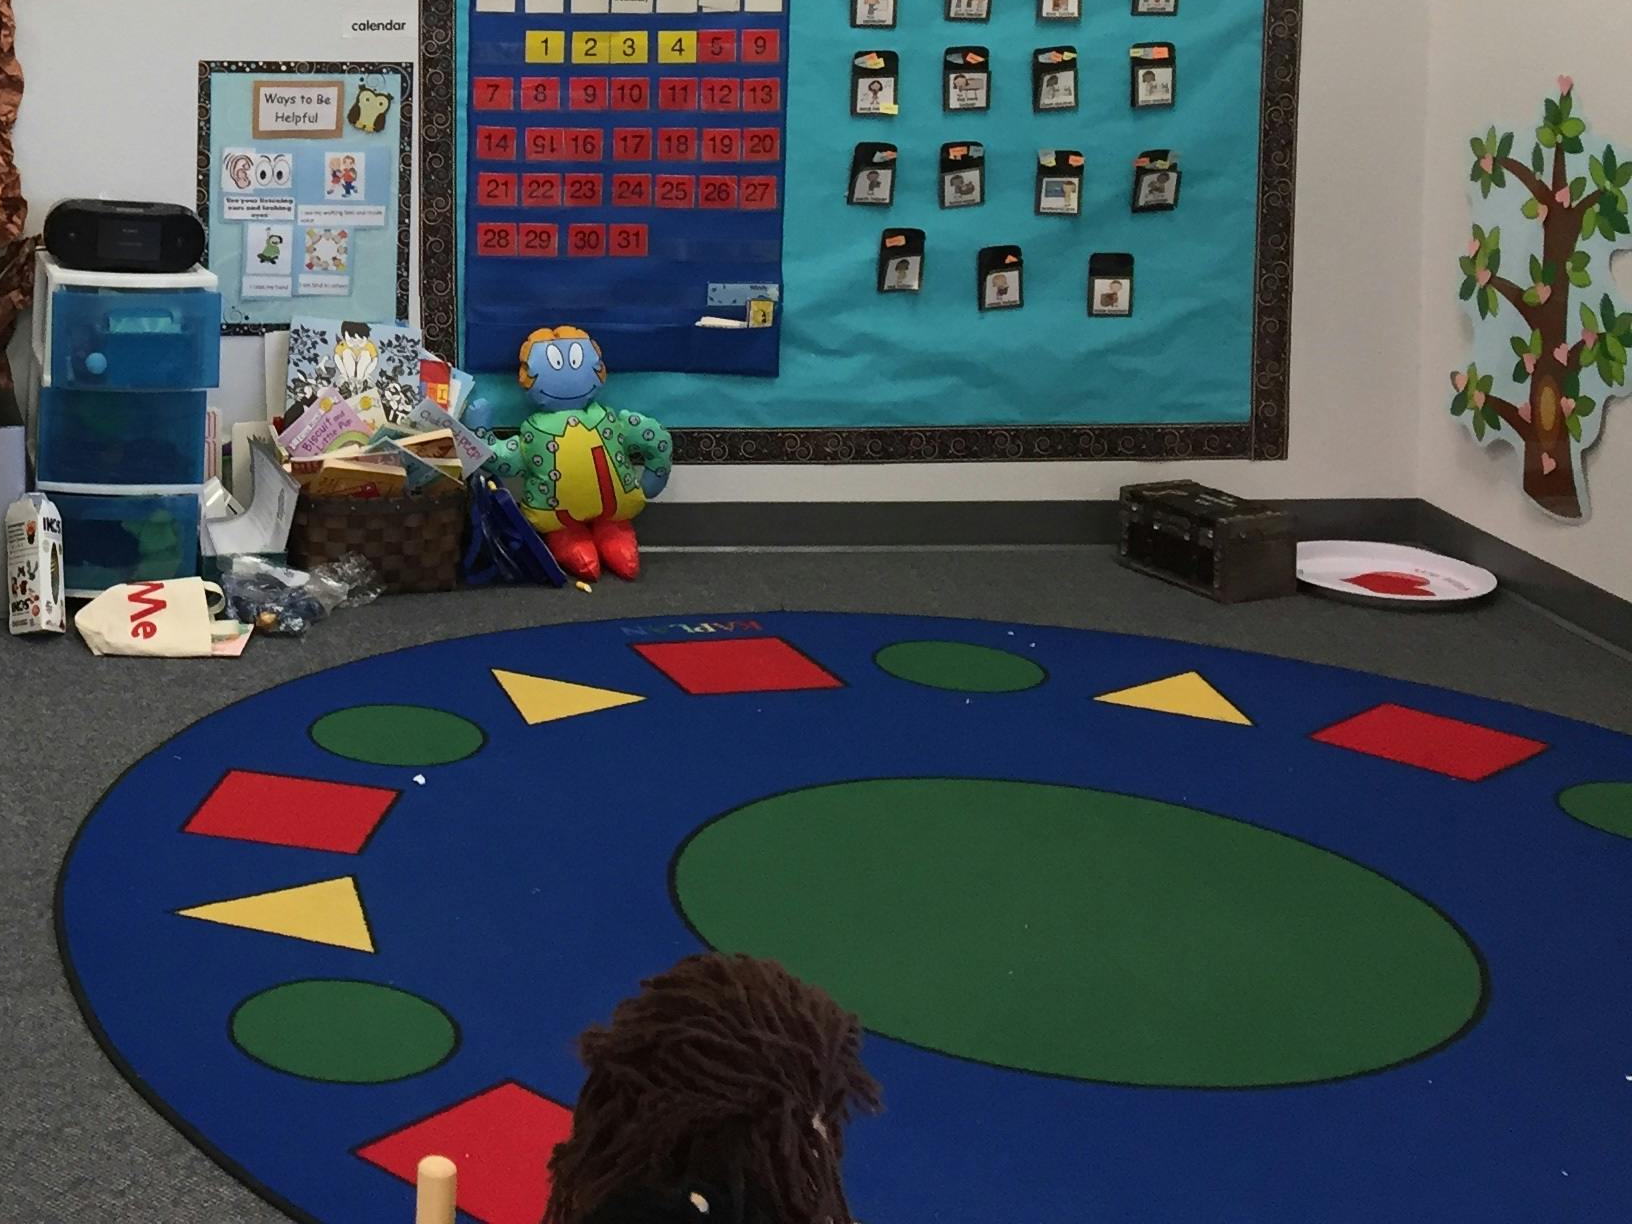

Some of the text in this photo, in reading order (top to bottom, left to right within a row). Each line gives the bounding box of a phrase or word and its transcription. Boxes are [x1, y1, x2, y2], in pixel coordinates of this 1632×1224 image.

[351, 20, 407, 32] calendar
[540, 37, 550, 57] 1
[584, 37, 598, 57] 2
[622, 37, 636, 57] 3
[670, 37, 685, 57] 4
[711, 36, 724, 57] 5
[264, 92, 332, 106] Ways to Be
[487, 84, 773, 105] 7 8 9 10 11 12 13
[275, 112, 319, 125] Helpful
[484, 133, 510, 153] 14
[571, 135, 596, 155] 16
[620, 135, 645, 154] 17
[665, 135, 689, 154] 18
[709, 135, 734, 155] 19
[749, 134, 774, 154] 20
[487, 179, 770, 202] 21 22 23 24 25 26 27
[483, 228, 641, 250] 28 29 30 31
[302, 418, 332, 452] Biscuit
[127, 581, 167, 640] Me
[619, 619, 764, 635] KAPLAN
